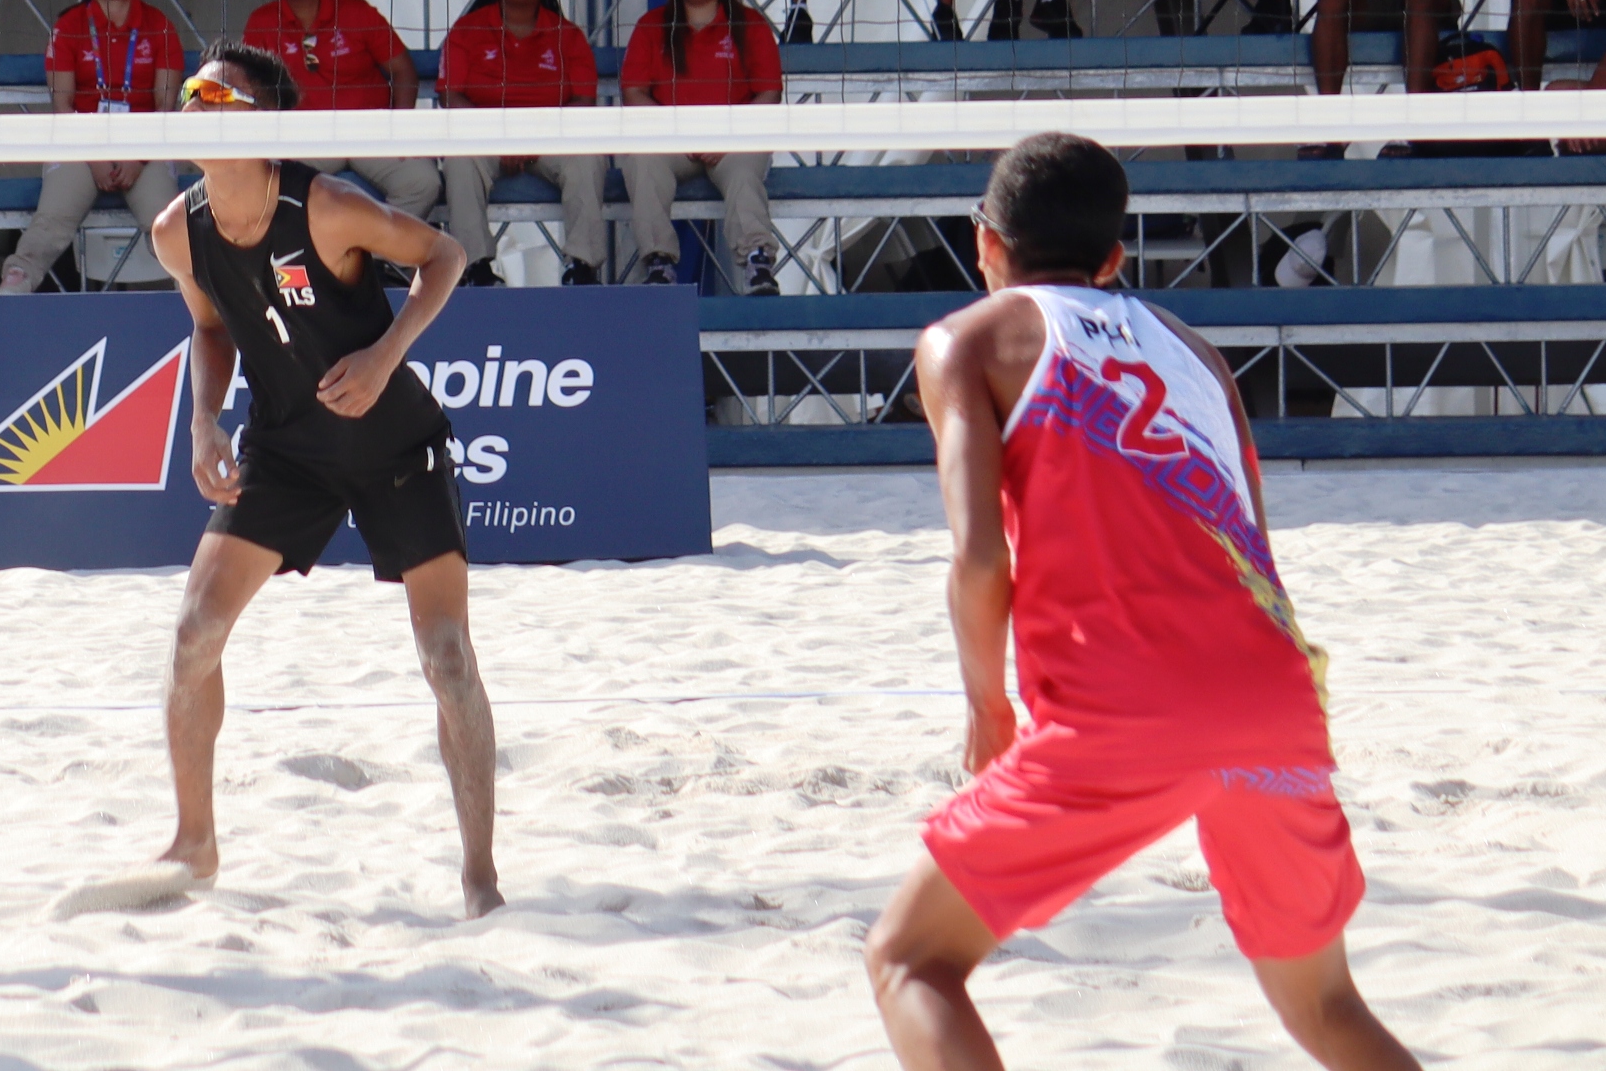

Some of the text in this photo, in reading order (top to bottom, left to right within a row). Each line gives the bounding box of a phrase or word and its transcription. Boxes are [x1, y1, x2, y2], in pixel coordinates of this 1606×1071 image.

[278, 286, 316, 307] TLS
[265, 305, 291, 344] 1
[1077, 314, 1142, 350] PHI
[1100, 355, 1191, 461] 2
[466, 500, 576, 535] Filipino
